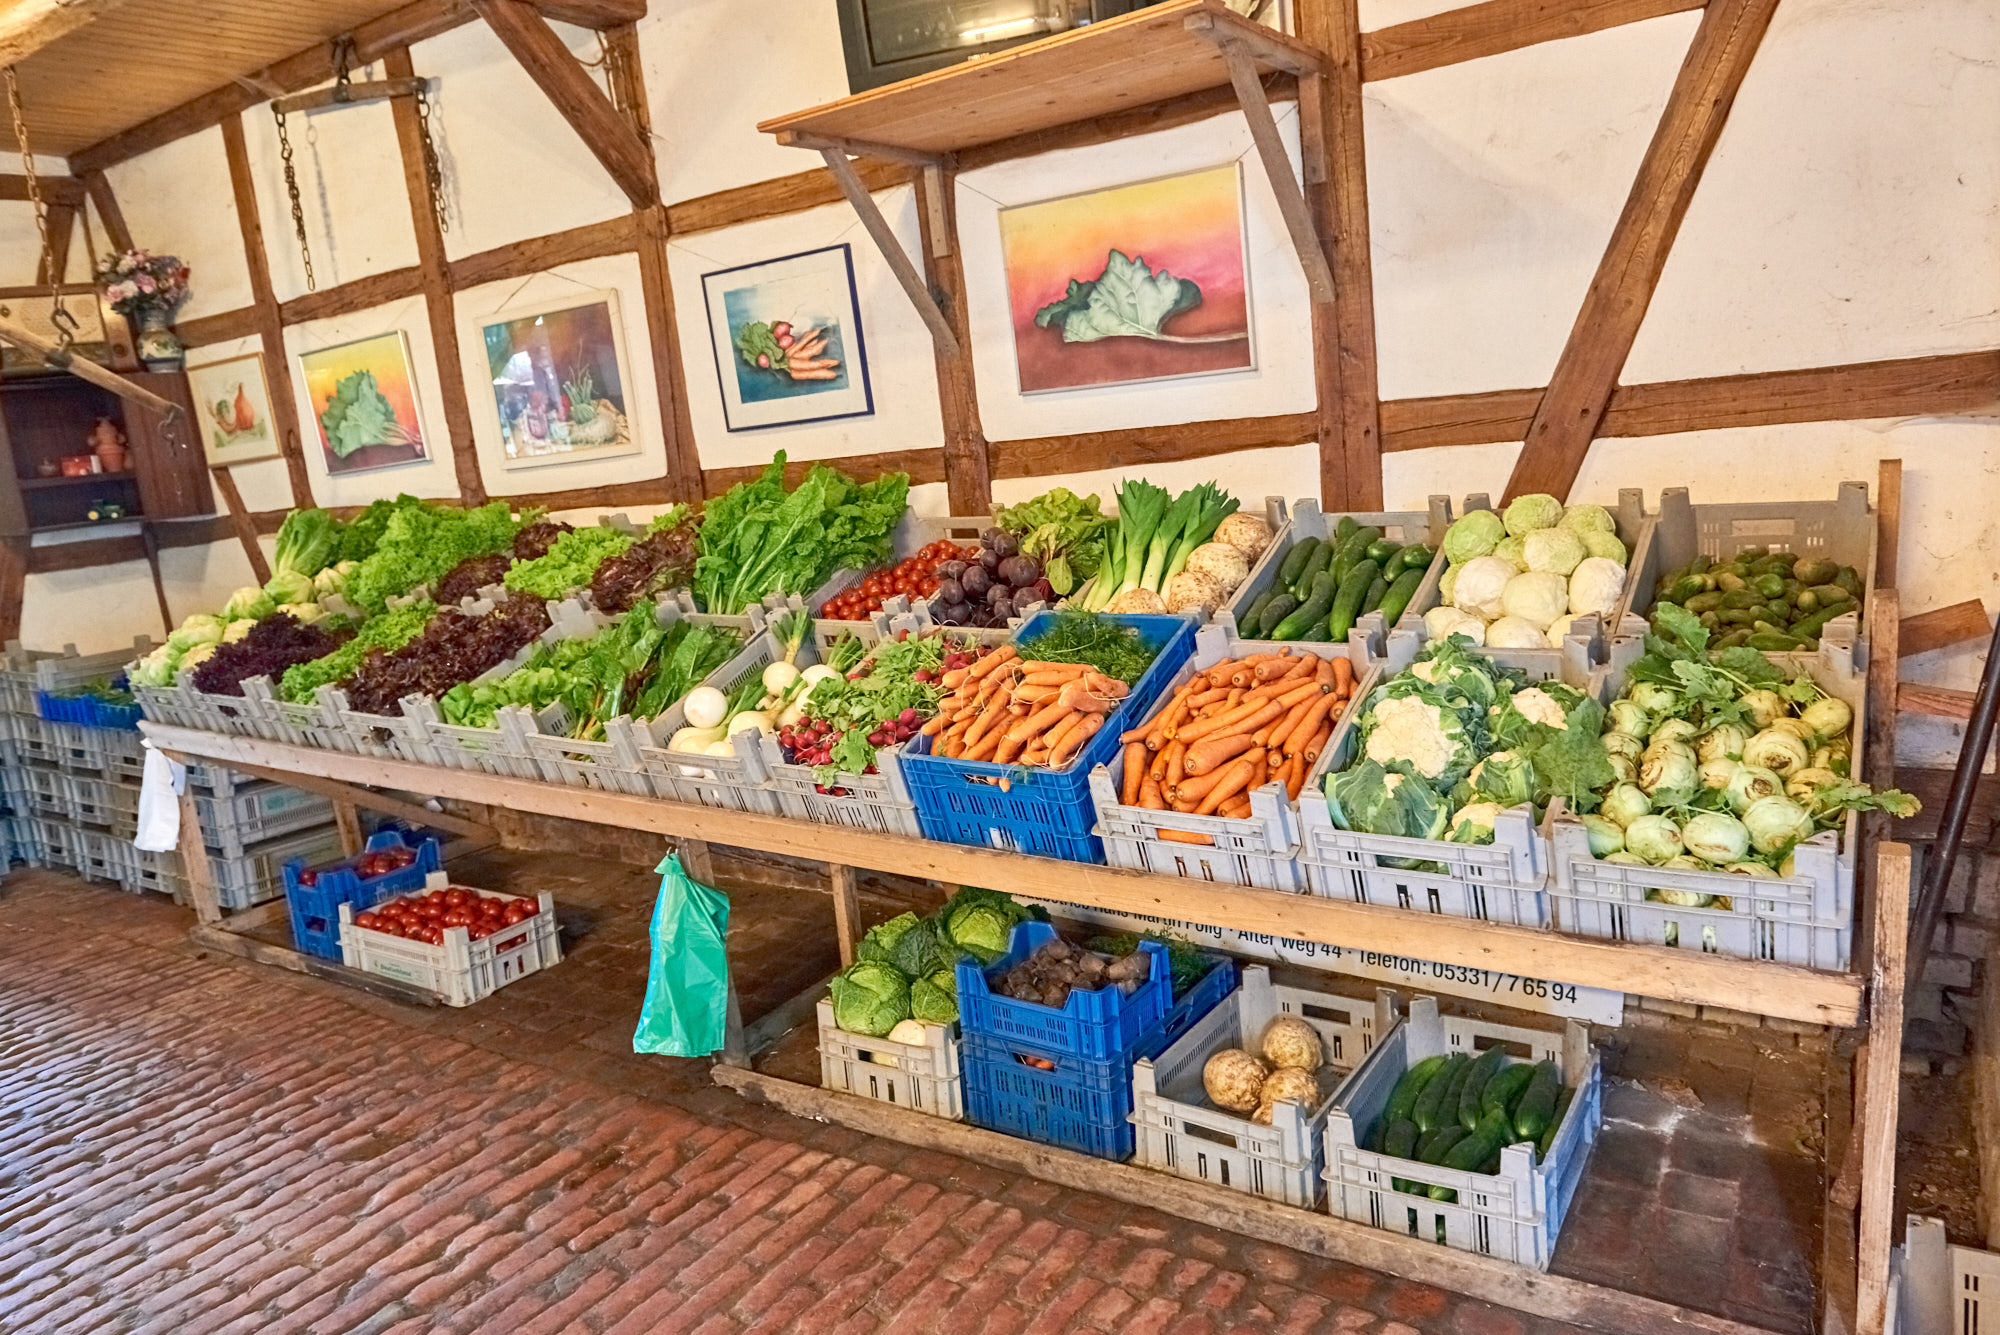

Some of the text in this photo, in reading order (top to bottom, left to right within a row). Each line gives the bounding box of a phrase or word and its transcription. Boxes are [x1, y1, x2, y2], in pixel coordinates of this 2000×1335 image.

[1281, 937, 1316, 957] Weg
[1320, 943, 1342, 959] 44
[1360, 950, 1427, 976] Telefon:
